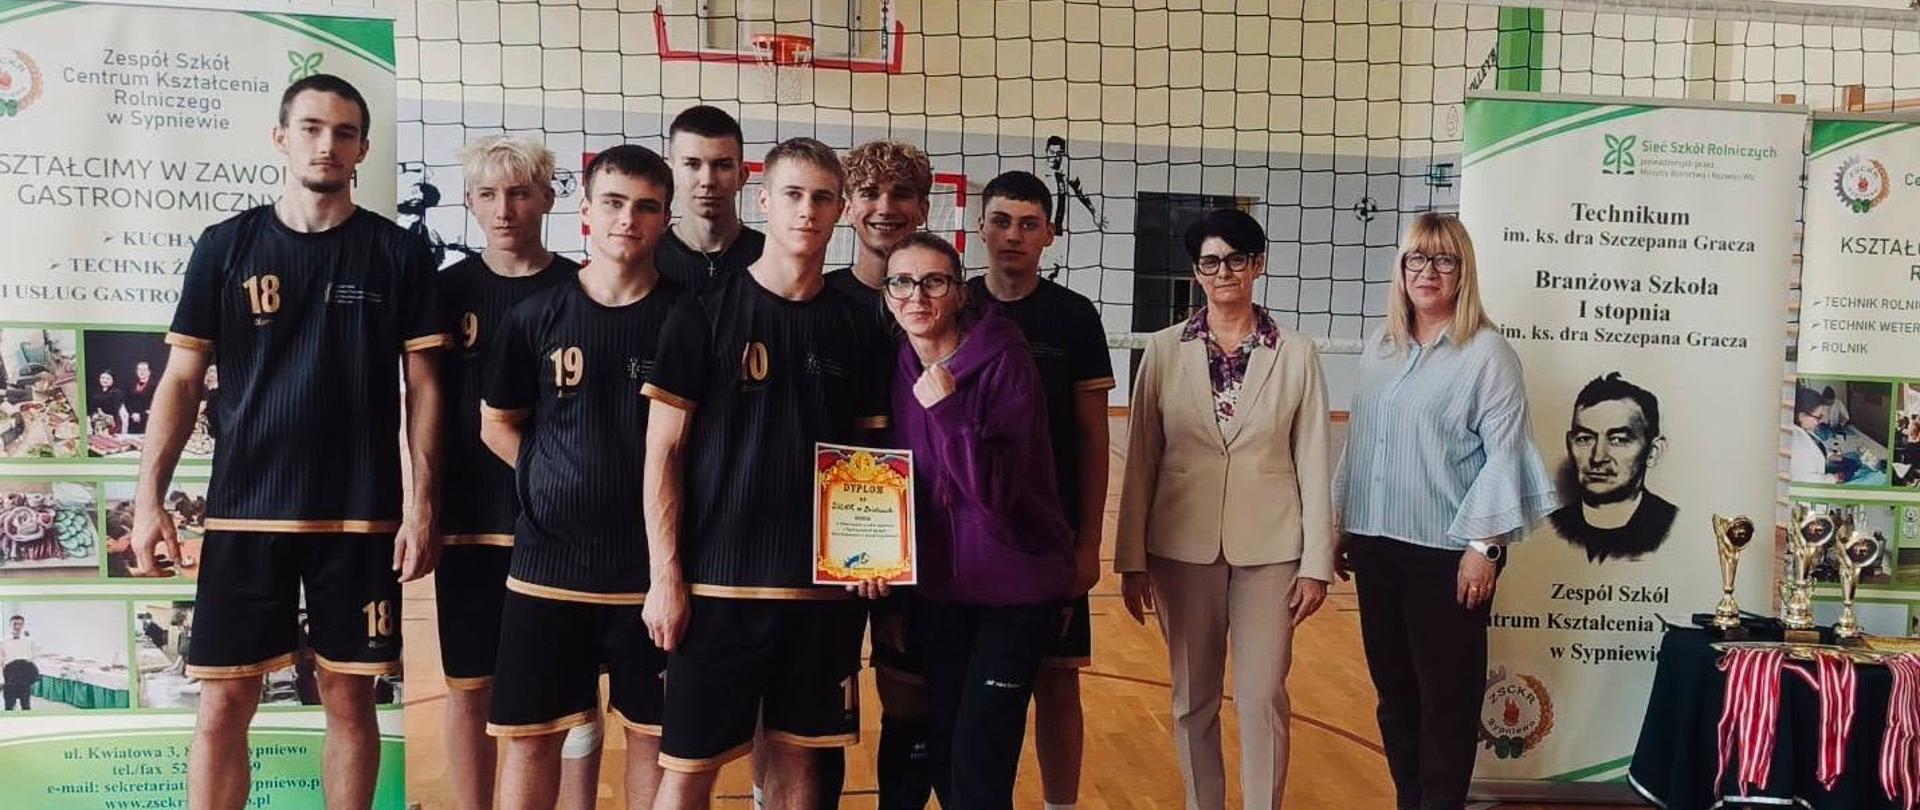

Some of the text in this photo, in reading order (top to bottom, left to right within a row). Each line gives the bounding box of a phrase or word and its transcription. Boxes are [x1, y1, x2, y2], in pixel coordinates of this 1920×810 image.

[102, 49, 230, 72] Zespół Szkół
[63, 67, 270, 94] Centrum Kształcenia
[114, 89, 222, 111] Rolniczego
[106, 110, 231, 131] w Sypniewie
[1641, 139, 1778, 161] Sieć Szkół Rolniczych
[161, 161, 187, 182] W
[1571, 202, 1691, 227] Technikum
[1503, 227, 1756, 253] im. ks. dra Szczepana Gracza
[1841, 237, 1920, 257] KSZTAŁ
[69, 258, 166, 276] TECHNIK
[1535, 269, 1642, 294] Branżowa
[243, 275, 281, 314] 18
[1825, 296, 1920, 311] TECHNIK ROLNI
[1578, 301, 1671, 325] I stopnia
[1501, 323, 1748, 349] im. ks. dra Szczepana Gracza
[1823, 318, 1877, 333] TECHNIK
[1821, 341, 1868, 355] ROLNIK
[549, 346, 584, 388] 19
[843, 484, 884, 495] DYPLOM
[362, 601, 393, 638] 18
[1549, 646, 1566, 659] w
[64, 745, 83, 760] ul.
[88, 745, 163, 761] Kwiatowa
[113, 763, 163, 777] tel./fax
[47, 781, 99, 795] e-mail:
[251, 778, 320, 791] pniewo.p
